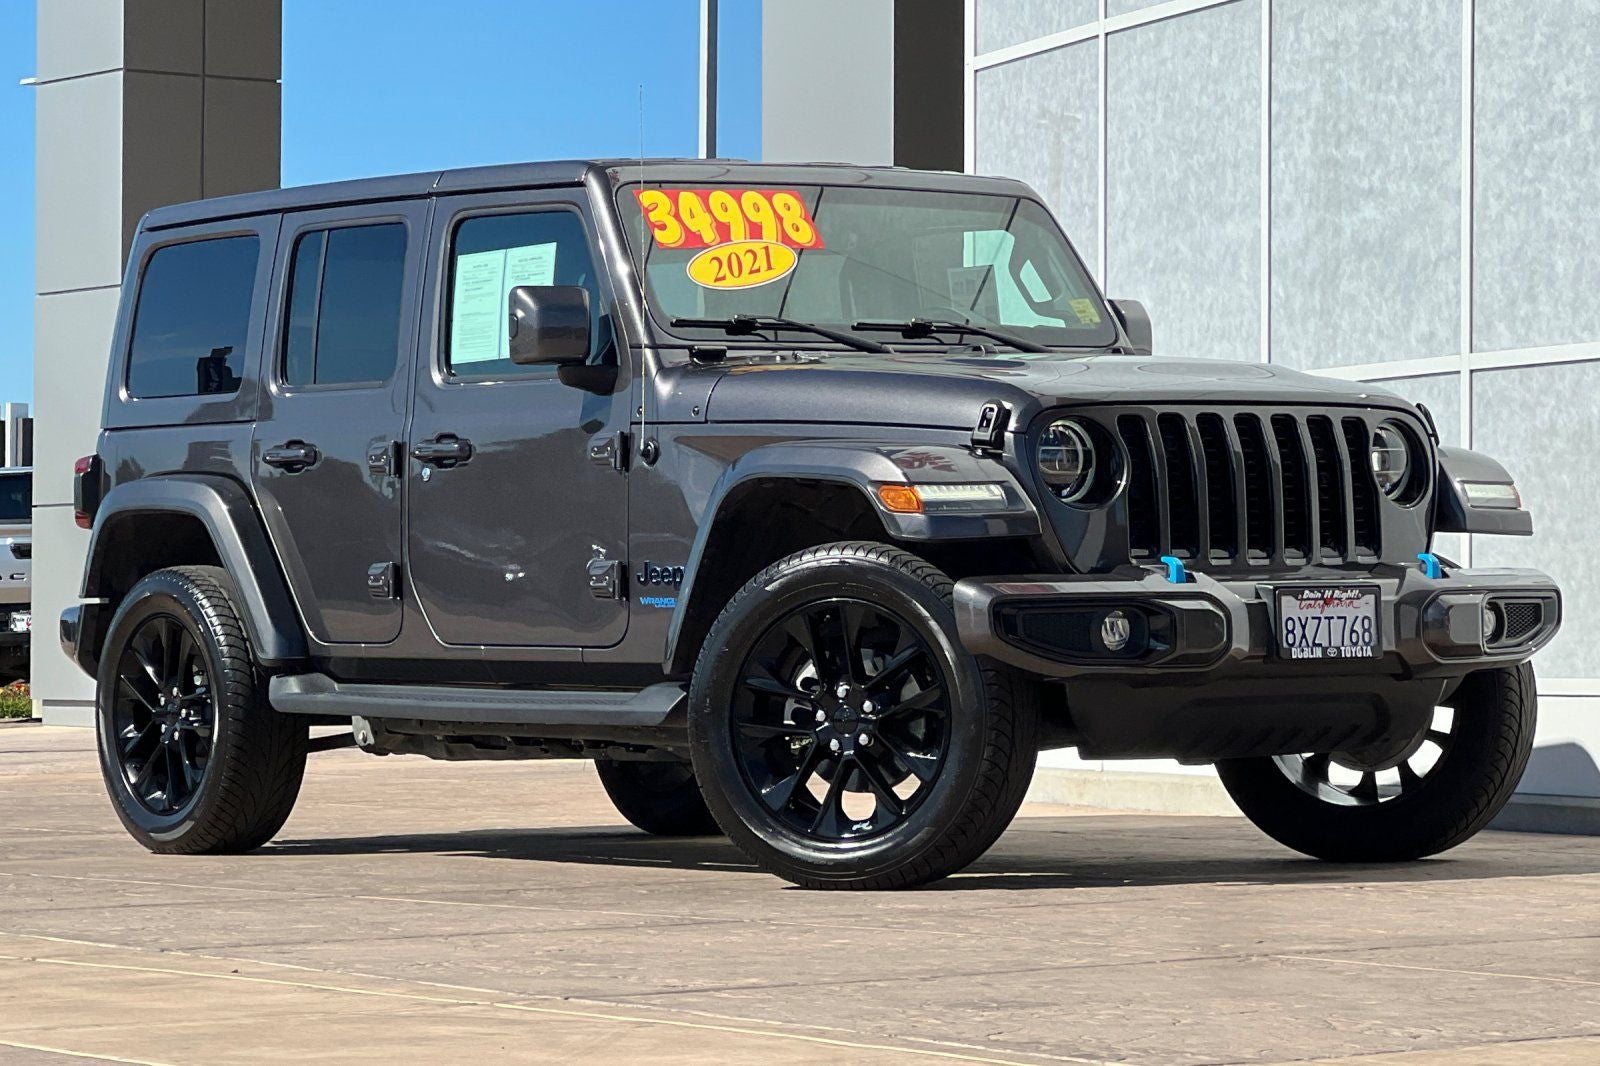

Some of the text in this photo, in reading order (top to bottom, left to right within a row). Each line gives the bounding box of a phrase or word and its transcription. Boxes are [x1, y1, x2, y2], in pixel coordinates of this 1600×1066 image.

[639, 190, 815, 247] 34998
[709, 245, 775, 283] 2021
[636, 560, 685, 591] Jeep
[1285, 616, 1373, 648] 8XZT768
[1291, 646, 1373, 659] DUBLIN TOYOTA
